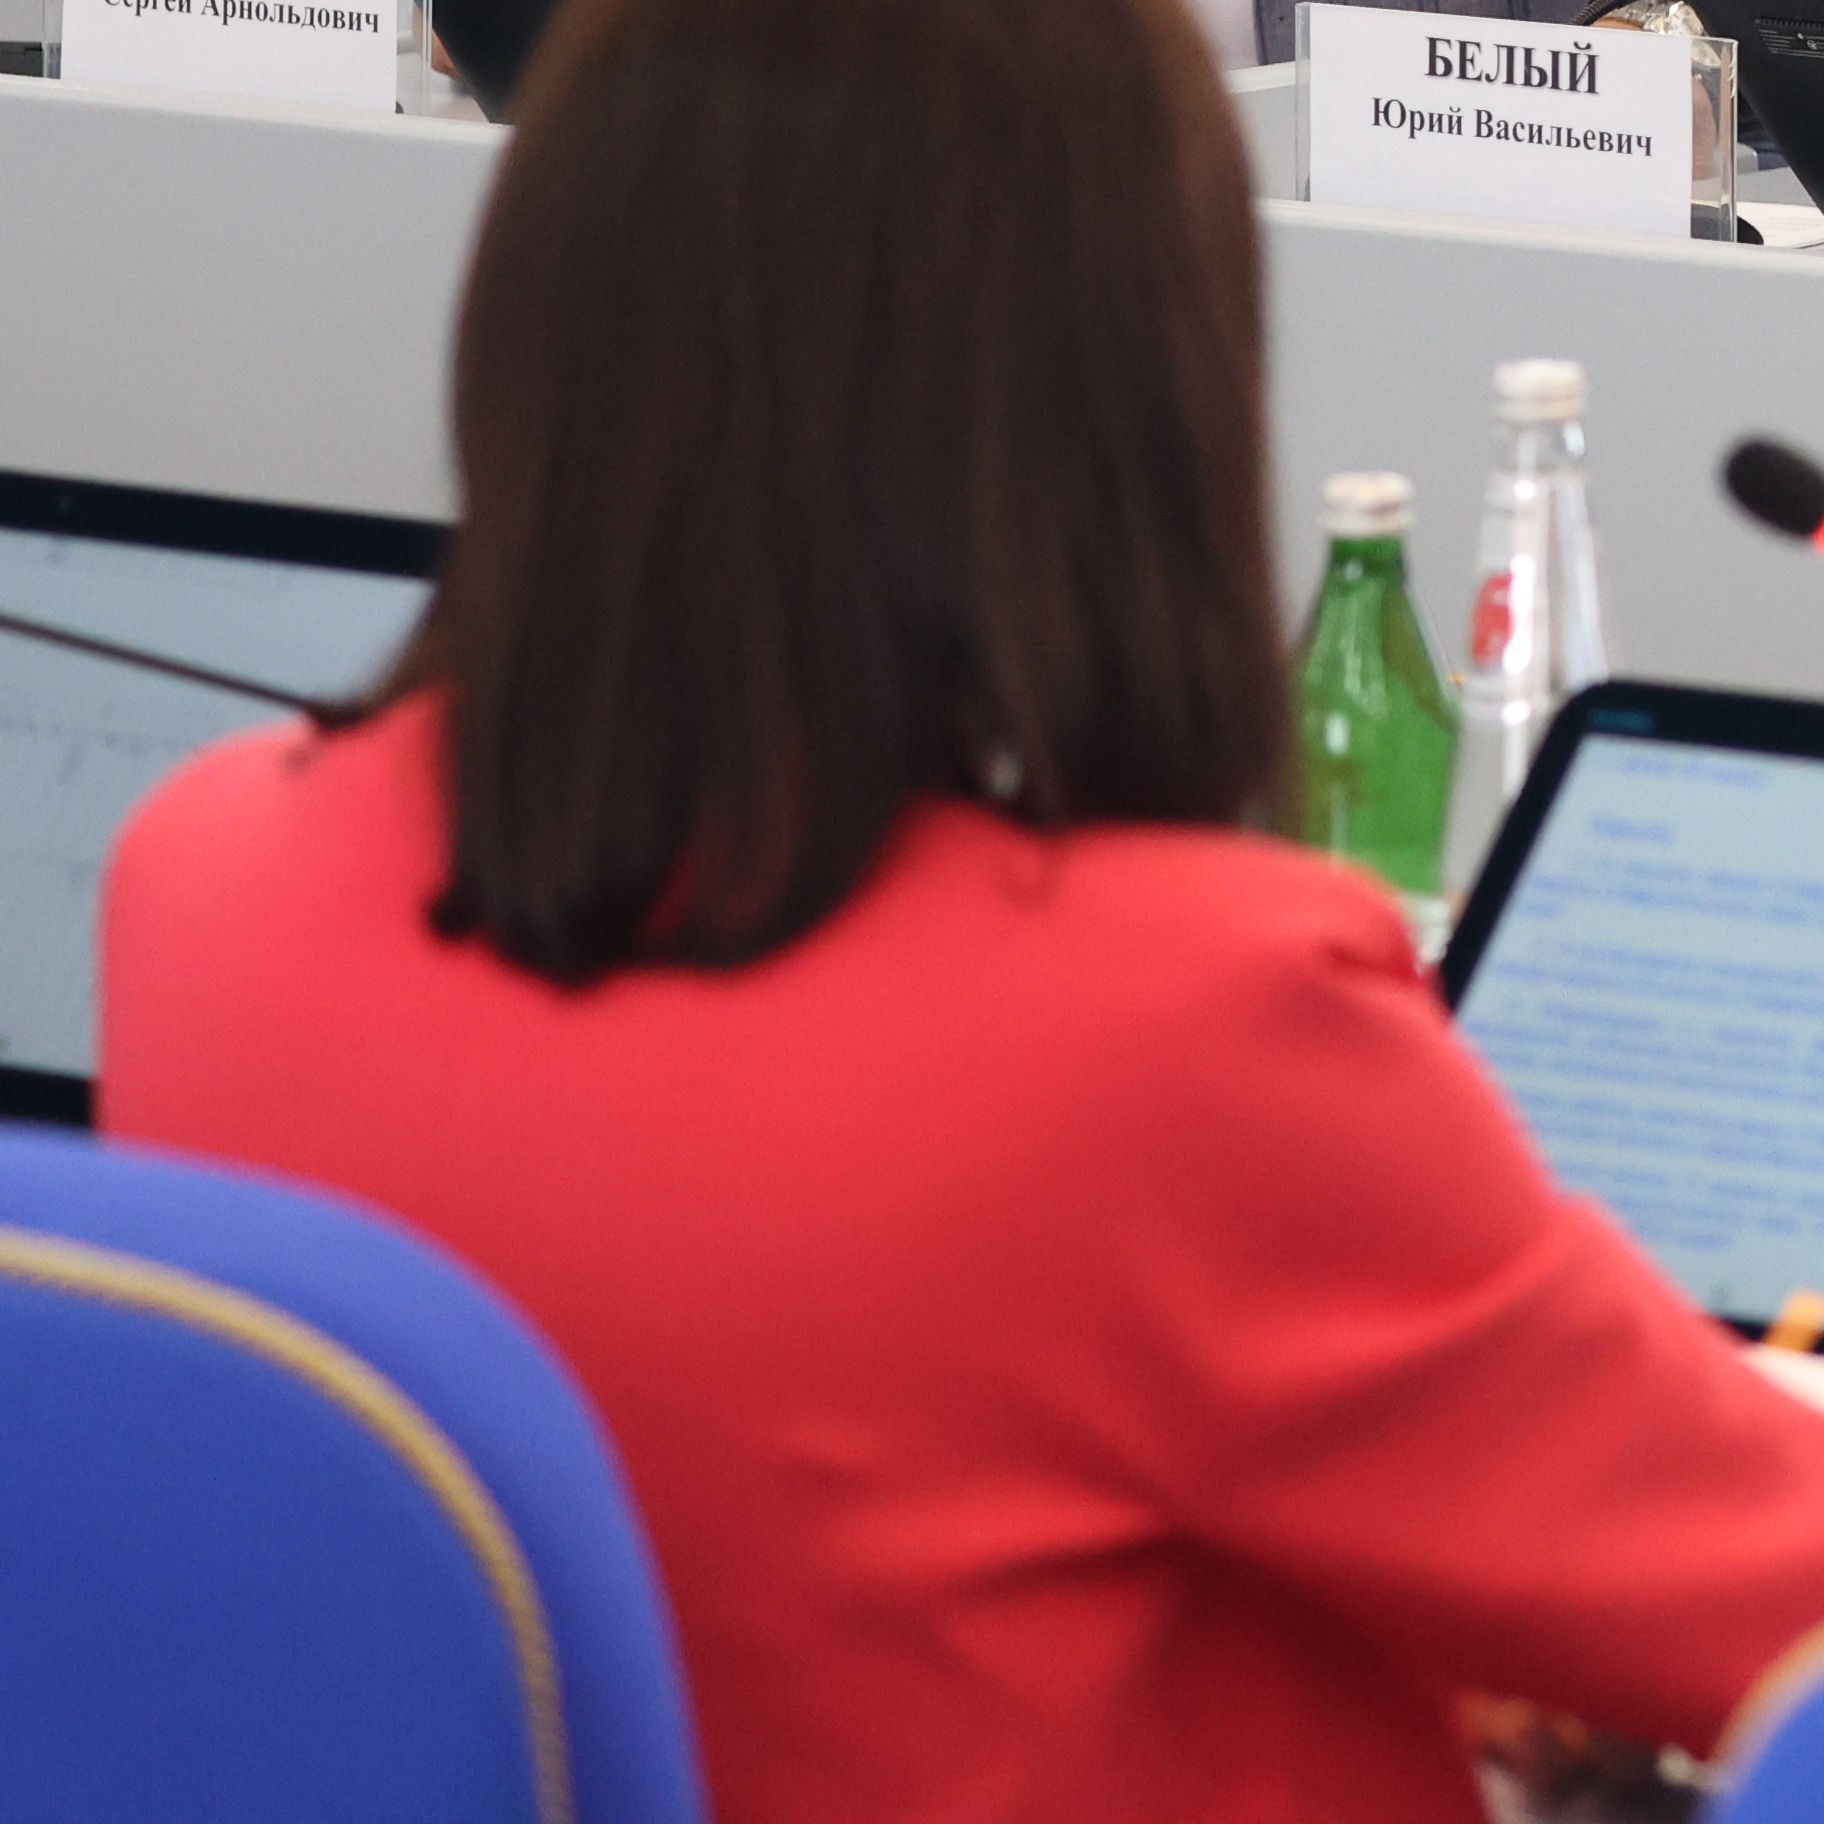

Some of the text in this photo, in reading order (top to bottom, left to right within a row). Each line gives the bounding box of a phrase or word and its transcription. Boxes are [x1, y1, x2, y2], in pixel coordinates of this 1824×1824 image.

[1425, 36, 1600, 95] БЕЛЫЙ
[1371, 97, 1653, 157] Юрий Васильевич
